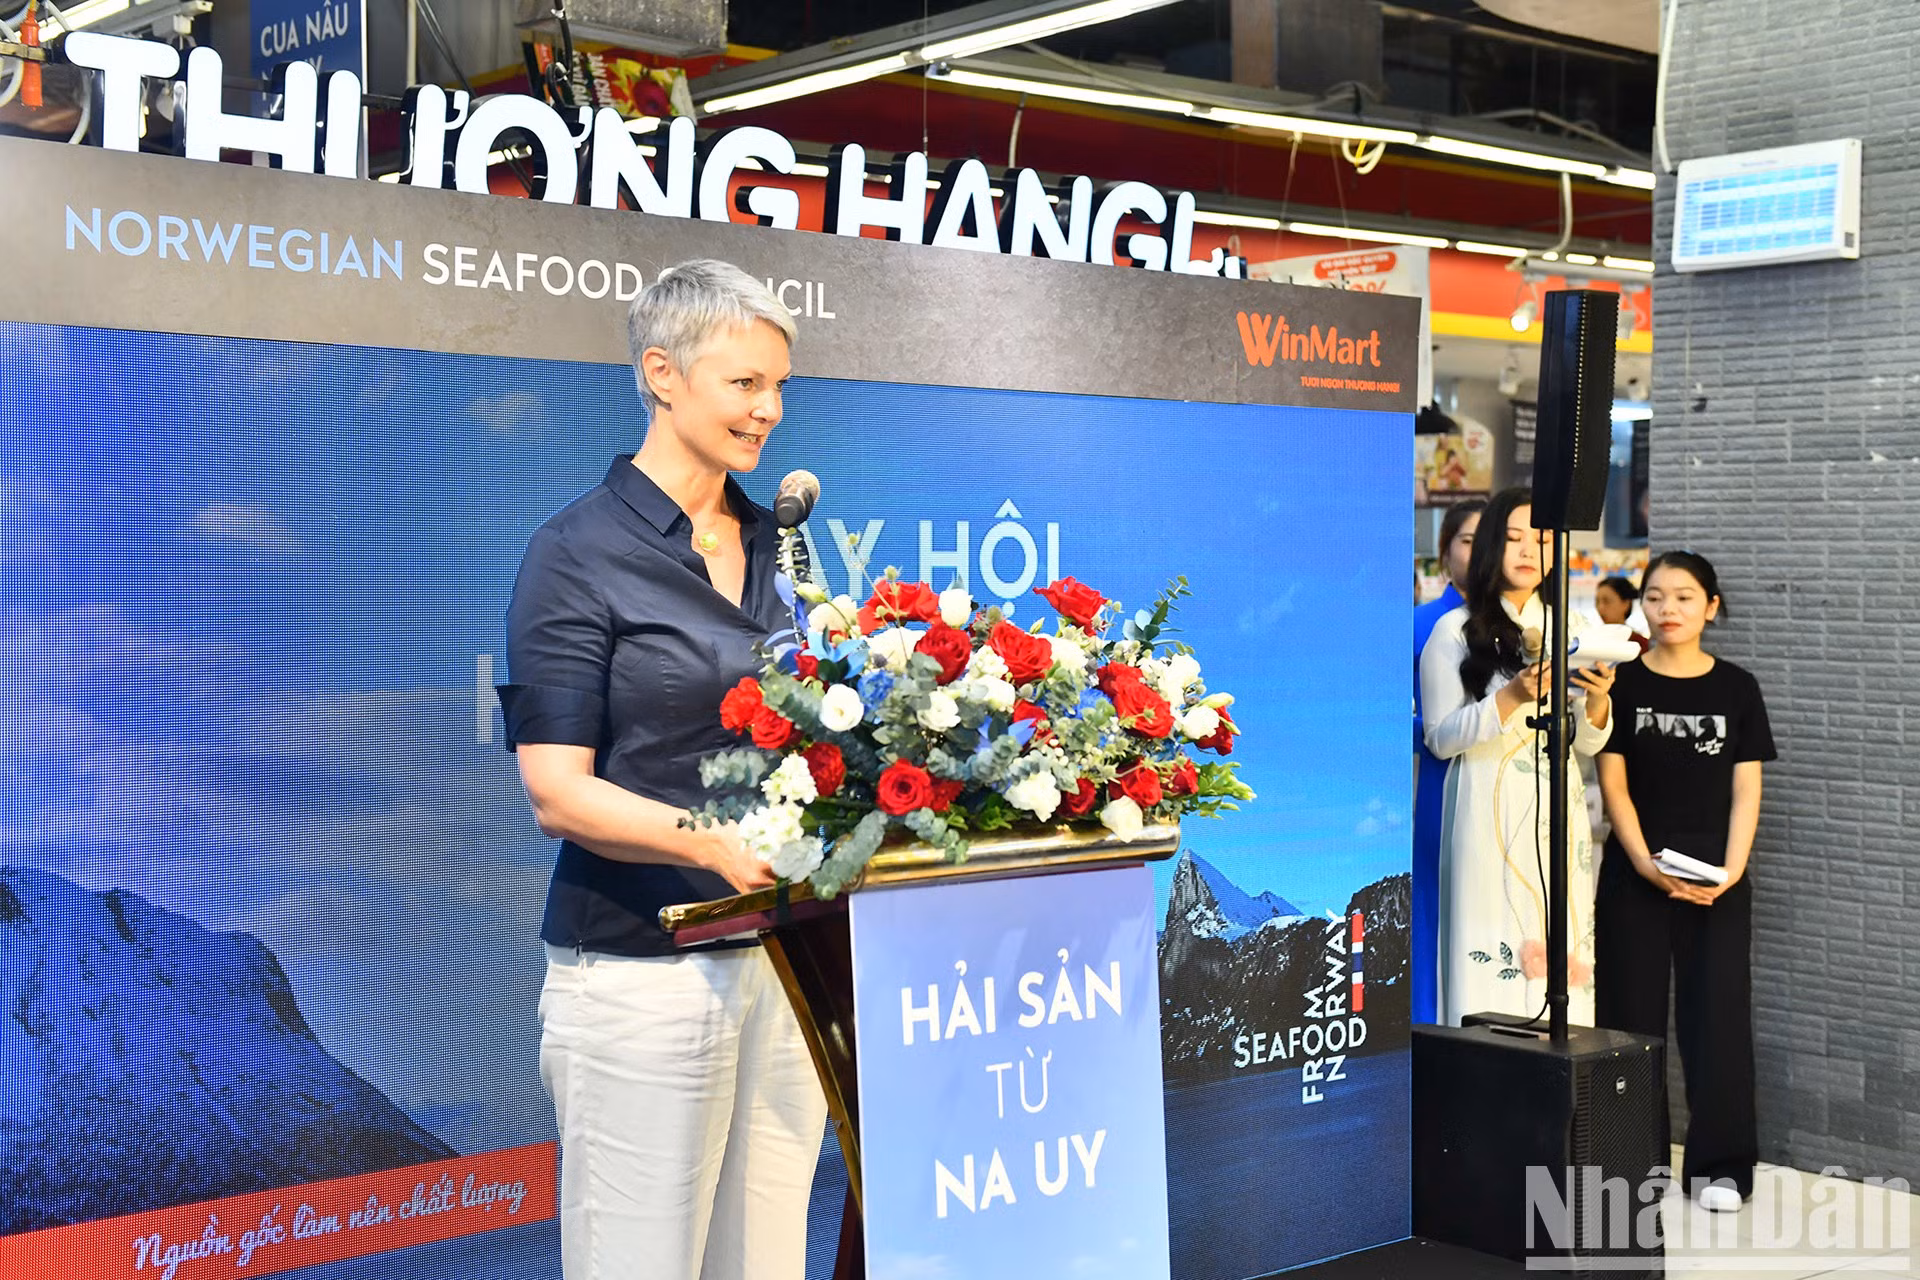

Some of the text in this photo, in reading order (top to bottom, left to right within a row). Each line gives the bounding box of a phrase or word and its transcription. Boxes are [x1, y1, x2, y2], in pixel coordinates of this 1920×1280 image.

[260, 0, 348, 57] CUA NÂU
[65, 204, 404, 281] NORWEGIAN
[423, 243, 643, 301] SEAFOOD
[1236, 311, 1381, 368] WinMart
[918, 498, 1060, 618] HỘI
[901, 947, 1123, 1046] HẢI SẢN
[985, 1046, 1053, 1119] TỪ
[1234, 1016, 1367, 1068] SEAFOOD
[934, 1129, 1107, 1219] NA UY
